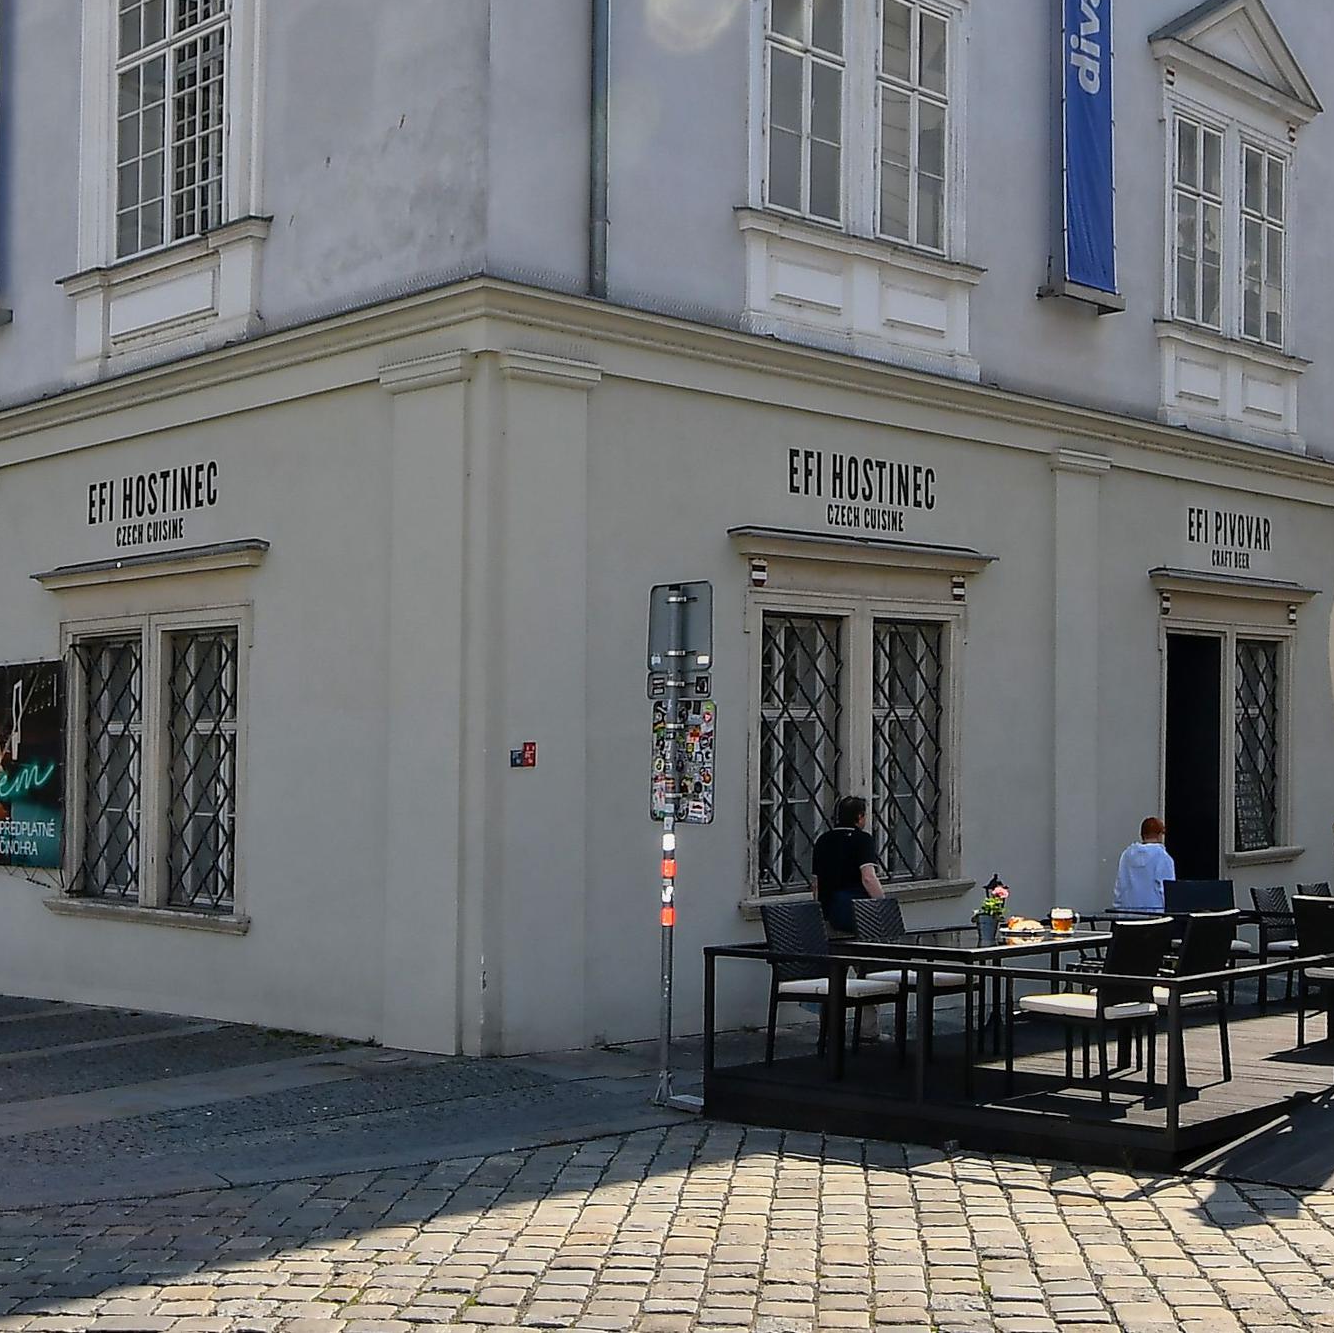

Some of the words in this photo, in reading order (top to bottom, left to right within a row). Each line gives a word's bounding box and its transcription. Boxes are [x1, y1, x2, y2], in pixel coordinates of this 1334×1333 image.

[88, 480, 114, 524] EFI
[122, 461, 217, 519] HOSTINEC
[789, 448, 822, 496] EFI
[832, 454, 935, 510] HOSTINEC
[116, 522, 144, 547] CZECH
[147, 517, 184, 542] CUISINE
[827, 504, 860, 528] CZECH
[864, 508, 904, 532] CUISINE
[1188, 507, 1208, 543] EFI
[1215, 511, 1271, 551] PIVOVAR
[1212, 549, 1232, 567] CRAFT
[1235, 551, 1250, 569] BEER
[0, 817, 55, 837] PŘEDPLATNÉ
[0, 836, 38, 855] ČINOHRA
